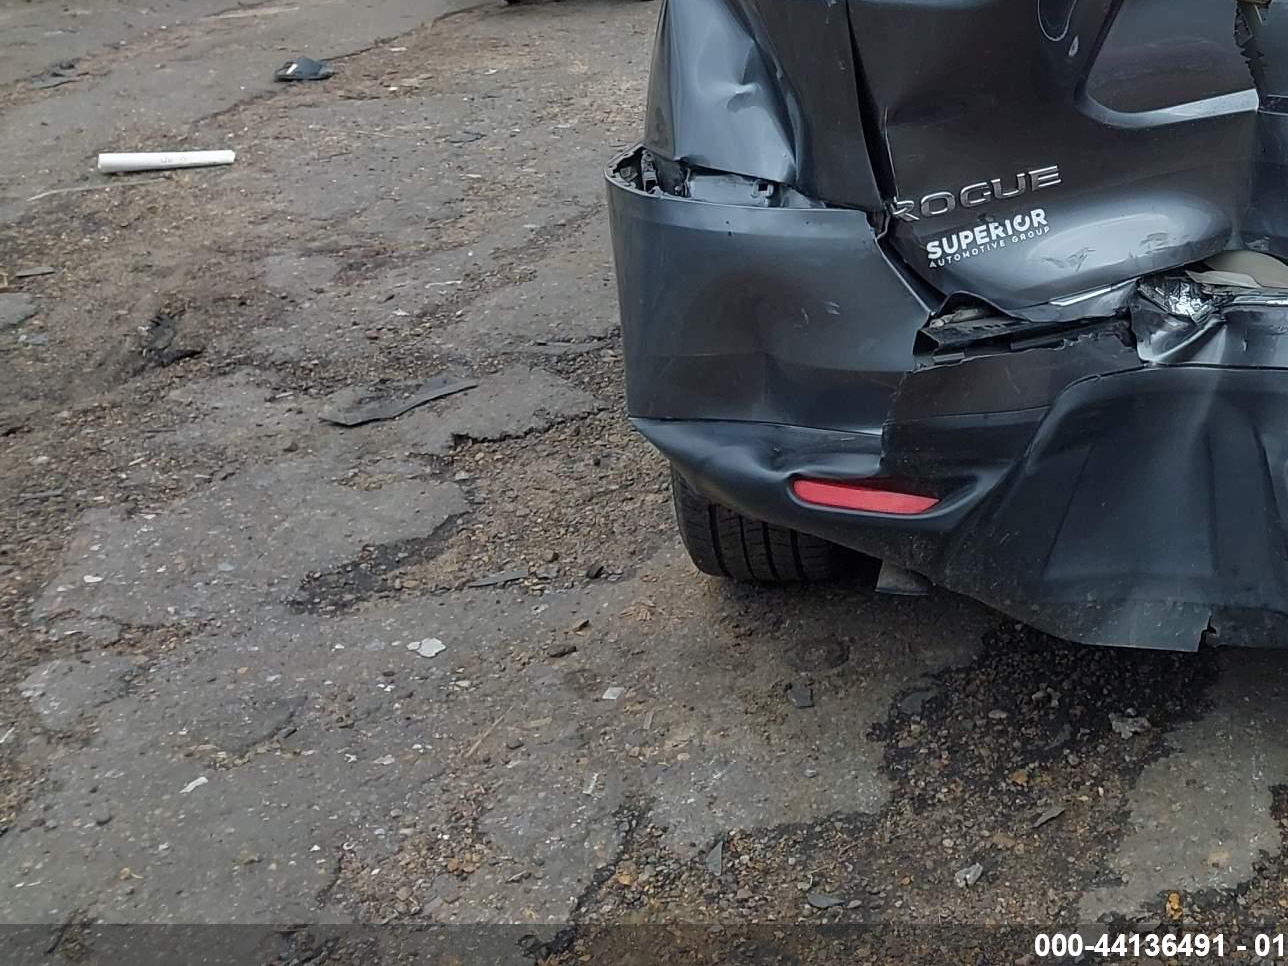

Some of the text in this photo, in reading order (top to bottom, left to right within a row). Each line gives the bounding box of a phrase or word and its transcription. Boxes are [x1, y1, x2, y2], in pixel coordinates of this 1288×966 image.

[889, 165, 1062, 221] ROGUE
[926, 207, 1048, 260] SUPERIOR
[929, 226, 1051, 269] AUTOMOTIVE GROUP
